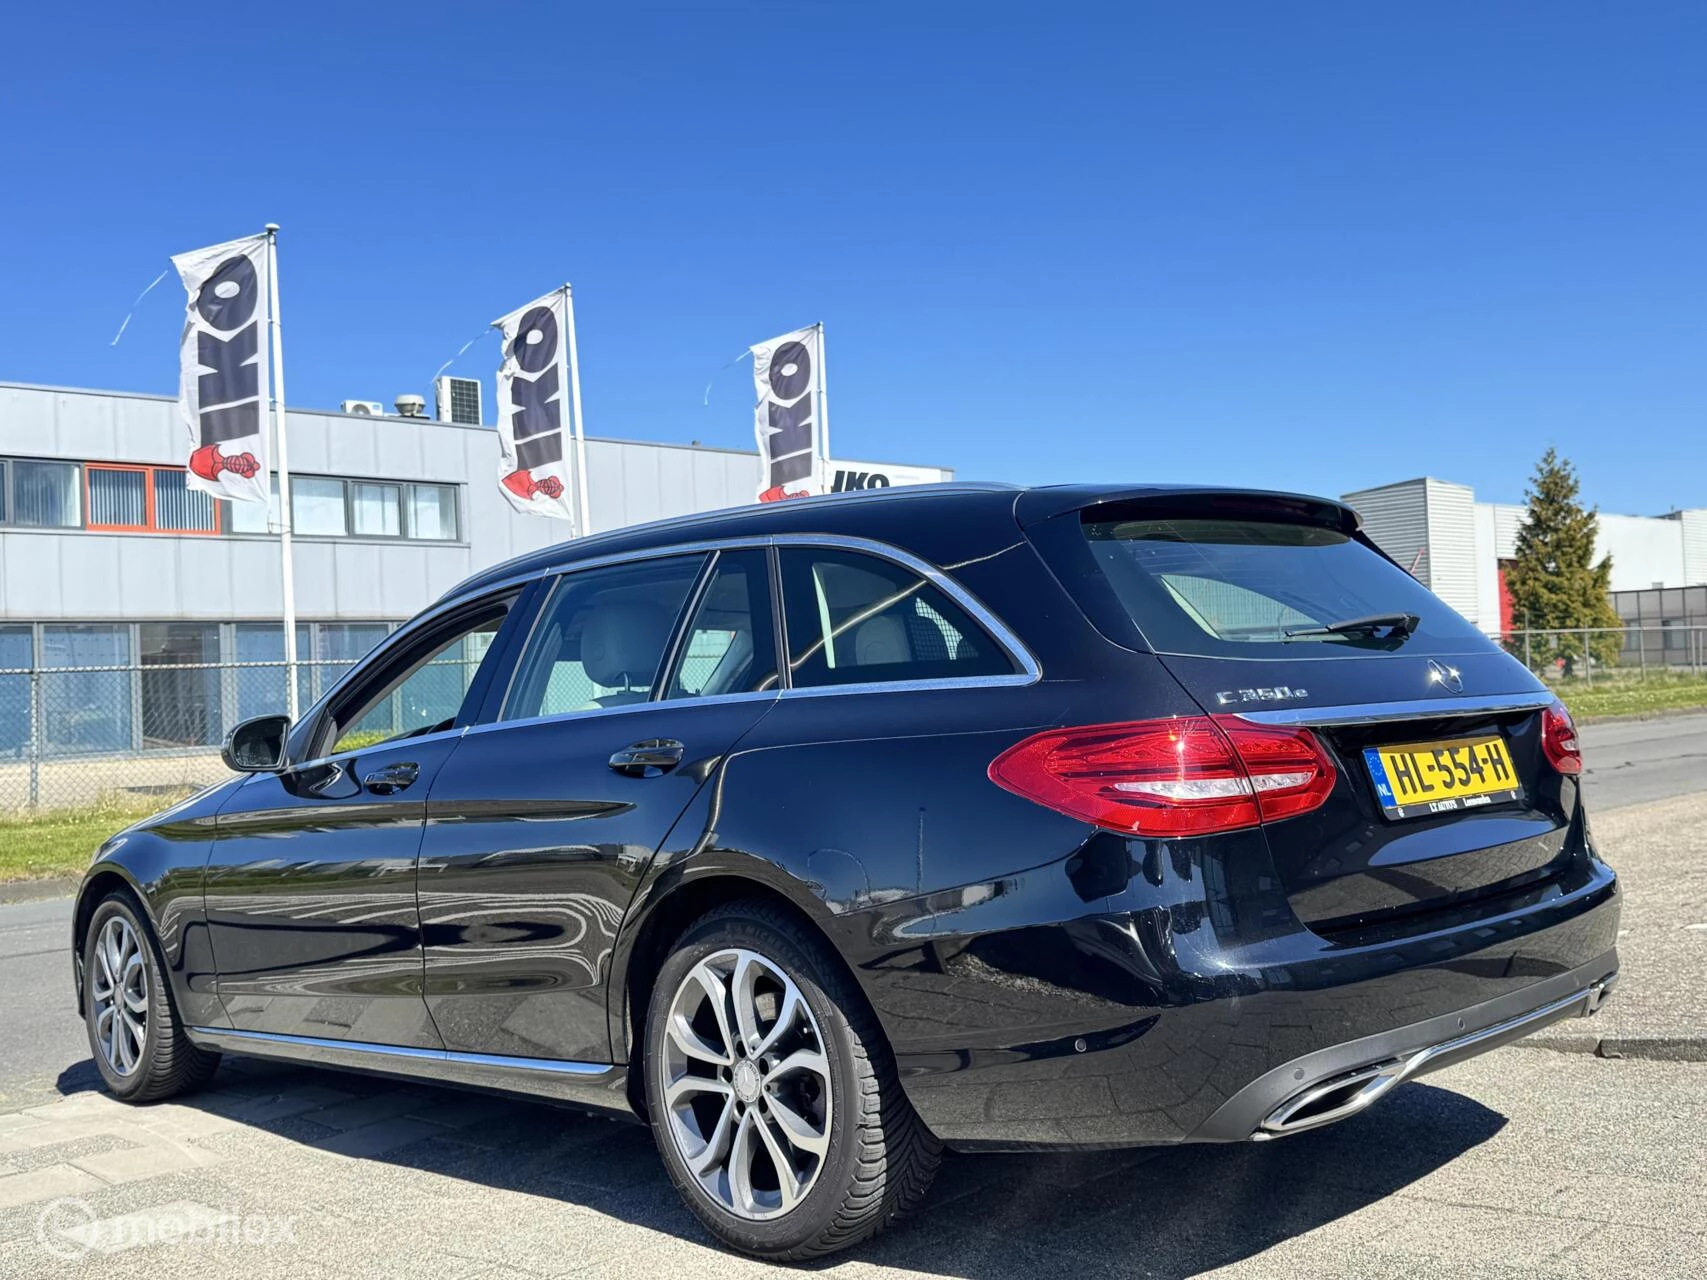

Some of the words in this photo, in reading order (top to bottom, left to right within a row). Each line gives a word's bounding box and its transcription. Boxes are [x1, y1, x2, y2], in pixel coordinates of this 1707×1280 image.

[197, 254, 259, 447] IKO
[511, 306, 562, 470] IKO
[768, 341, 812, 488] IKO
[1216, 691, 1237, 704] C
[1377, 783, 1391, 796] NL
[1390, 743, 1510, 796] HL-554-H
